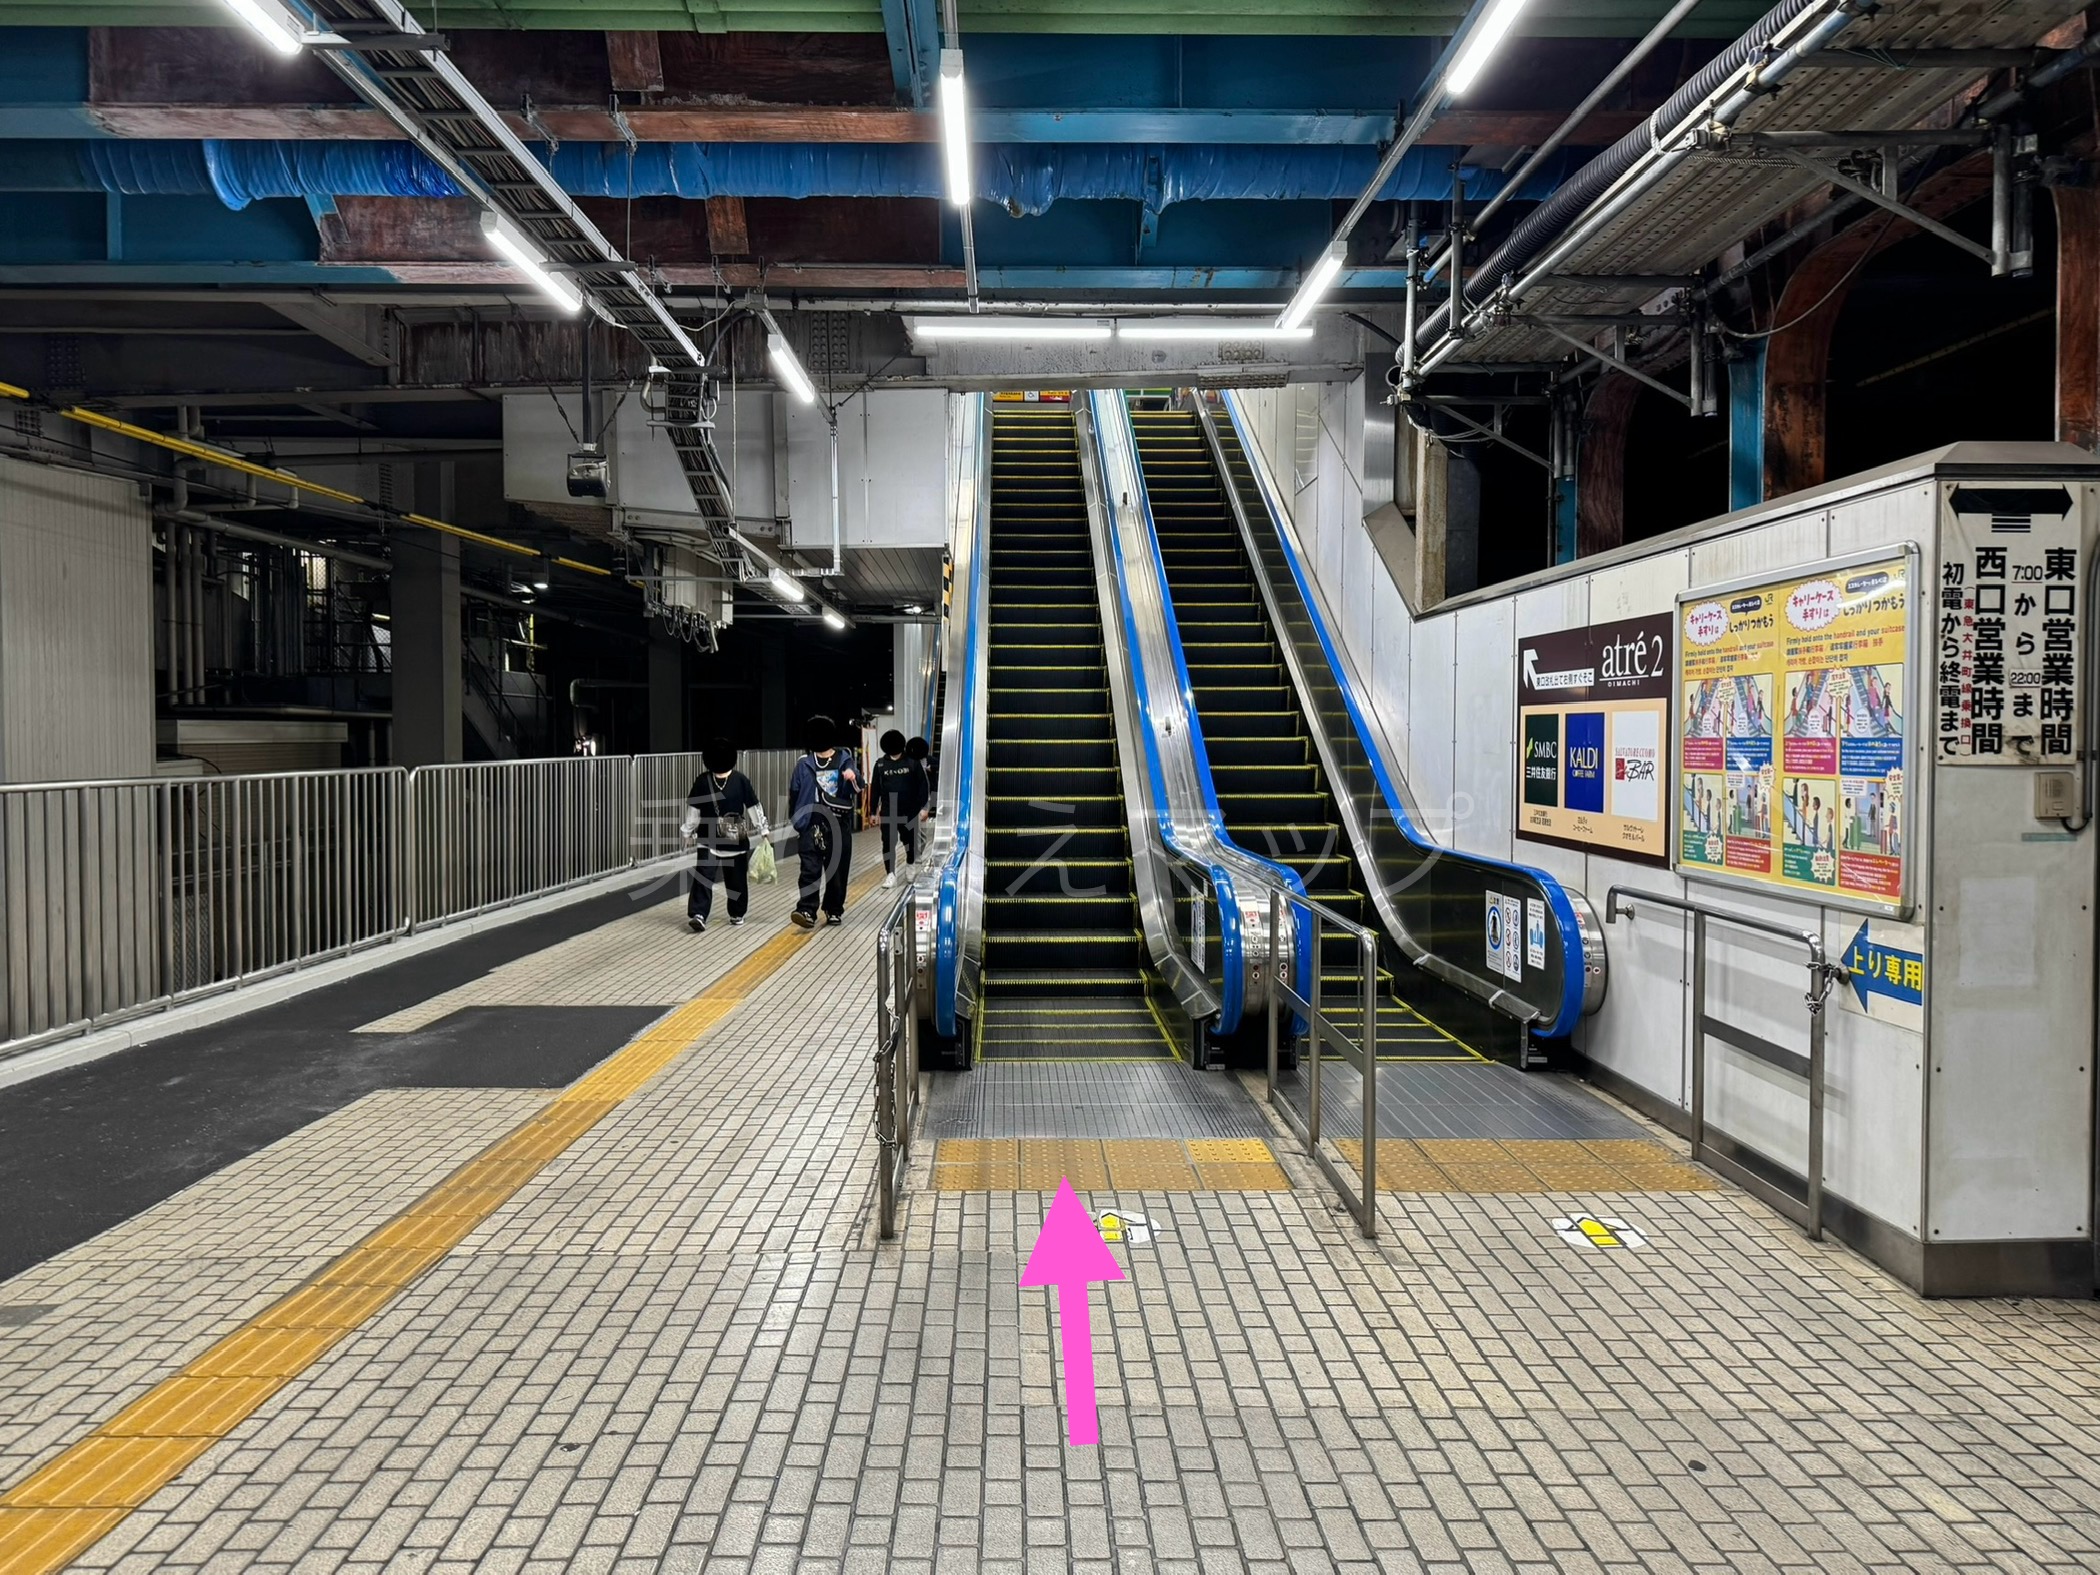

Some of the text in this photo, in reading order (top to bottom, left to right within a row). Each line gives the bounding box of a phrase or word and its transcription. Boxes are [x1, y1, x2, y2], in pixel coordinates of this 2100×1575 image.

[1793, 590, 1834, 607] キャリーケース
[1843, 593, 1905, 616] しっかりつかもう
[1690, 610, 1722, 625] キャリーケース
[1729, 613, 1774, 633] しっかりつかもう
[1802, 608, 1829, 621] 手すりは
[1698, 625, 1719, 637] 手すりは
[1602, 631, 1664, 677] atré 2
[1939, 562, 1965, 755] 初電から終電まで
[1971, 547, 2007, 755] 西口営業時間
[2040, 547, 2077, 755] 東口営業時間
[1607, 679, 1640, 688] OIMACHI
[1534, 741, 1557, 759] SMBC
[1570, 747, 1598, 769] KALDI
[1848, 946, 1922, 991] 上り専用
